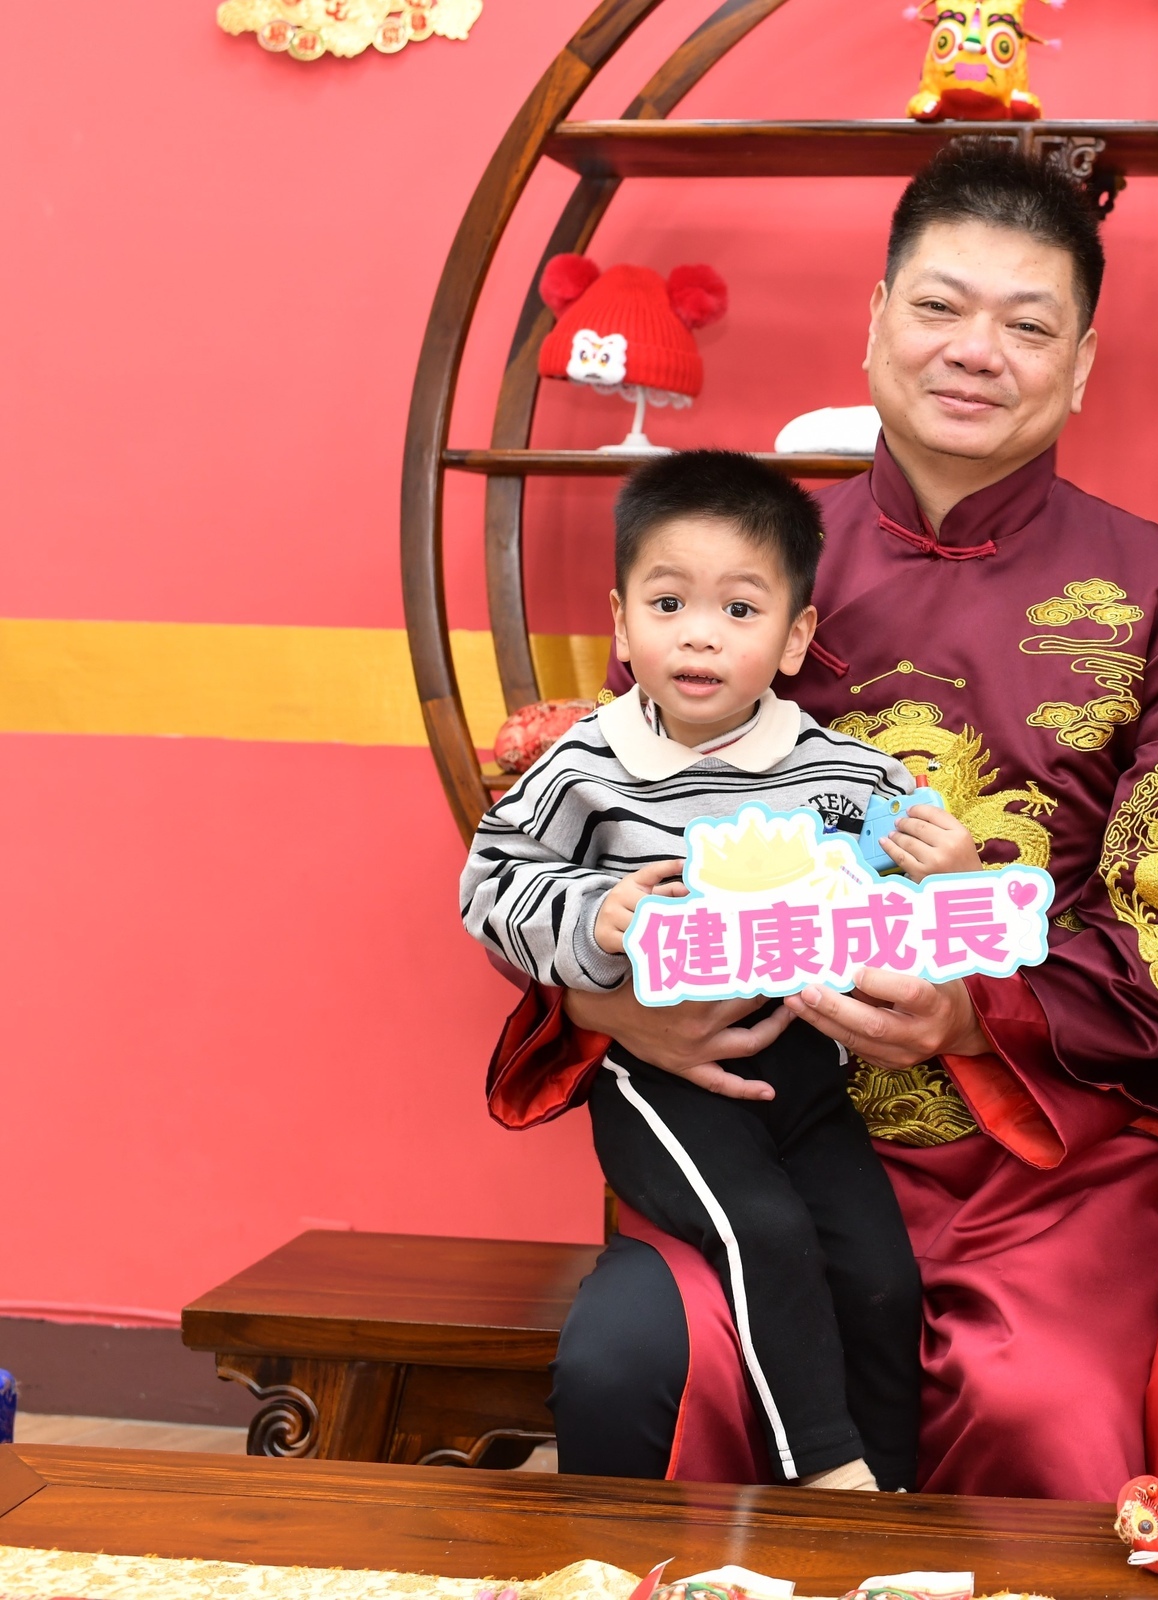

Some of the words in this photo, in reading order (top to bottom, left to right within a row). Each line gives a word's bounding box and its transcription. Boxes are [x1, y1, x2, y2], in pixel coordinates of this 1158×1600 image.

[800, 792, 865, 819] TEVE
[638, 887, 1010, 992] 健康成長
